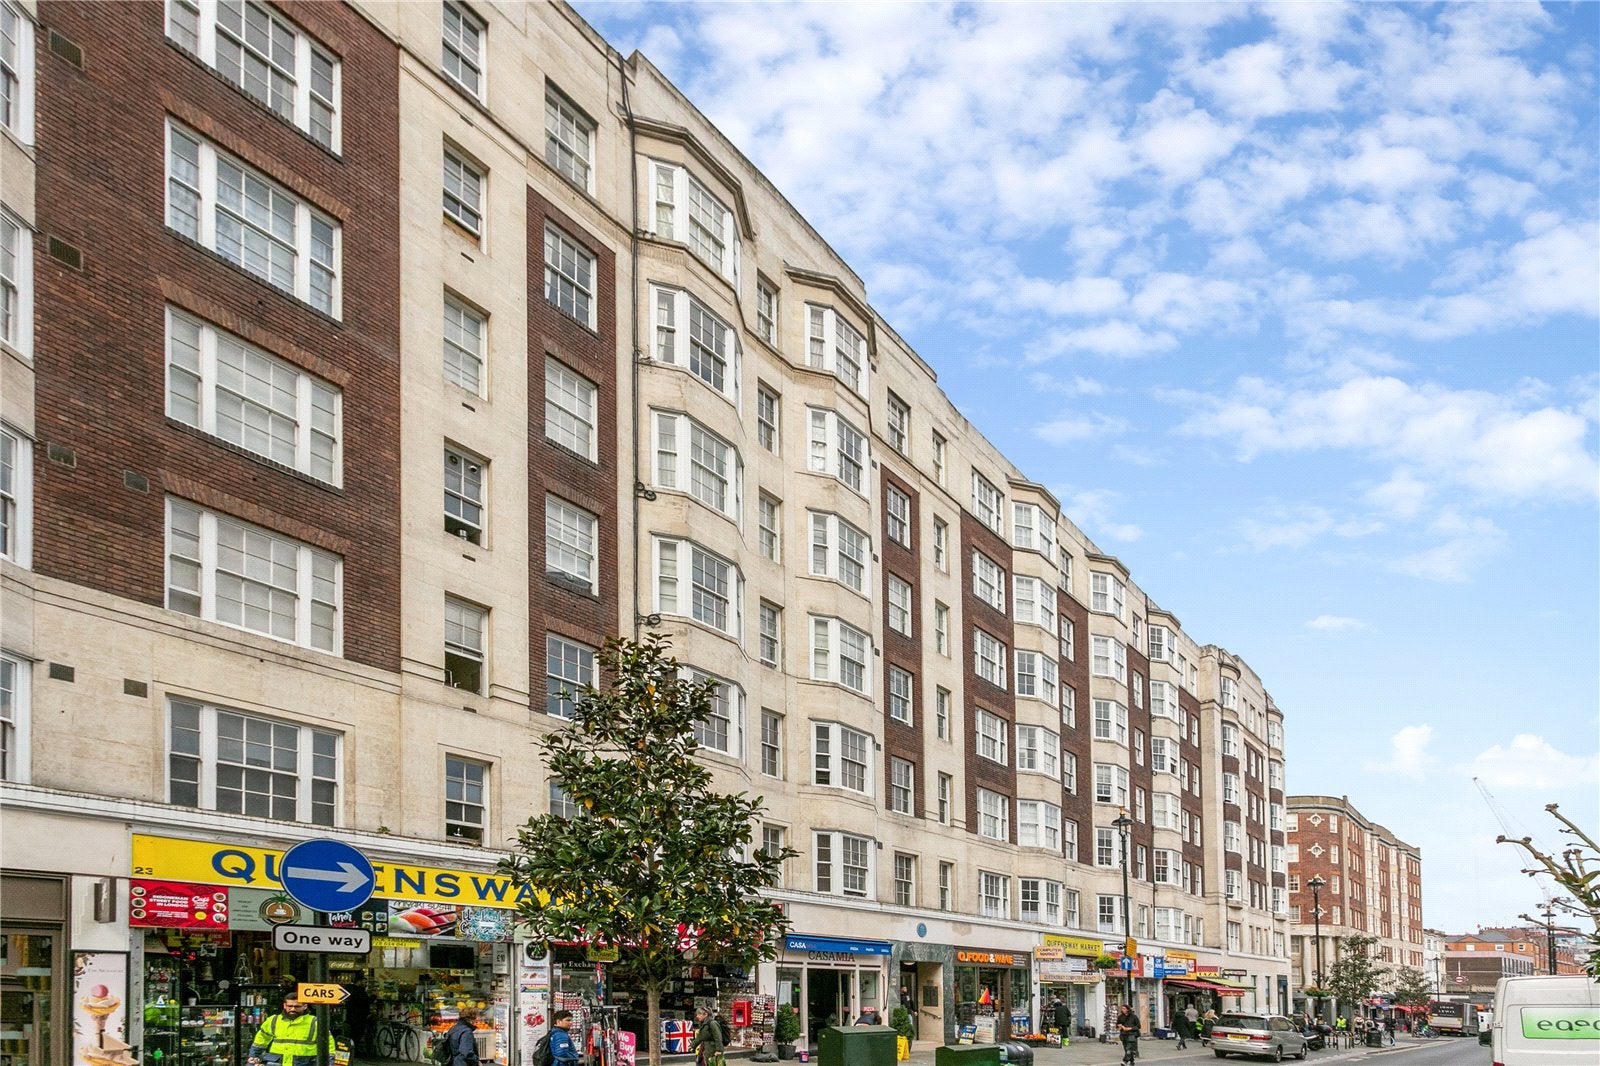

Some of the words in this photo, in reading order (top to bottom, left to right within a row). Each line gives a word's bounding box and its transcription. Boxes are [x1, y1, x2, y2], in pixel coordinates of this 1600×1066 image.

[134, 867, 153, 875] 23
[212, 849, 562, 906] QNSWA
[283, 931, 321, 945] One
[328, 935, 363, 948] way
[1047, 940, 1078, 949] QUEENSWAY
[808, 951, 855, 962] CASAMIA
[568, 960, 605, 969] Exchane
[304, 988, 334, 998] CARS
[617, 1032, 629, 1042] We
[620, 1041, 634, 1054] Buy
[617, 1052, 635, 1062] Gold
